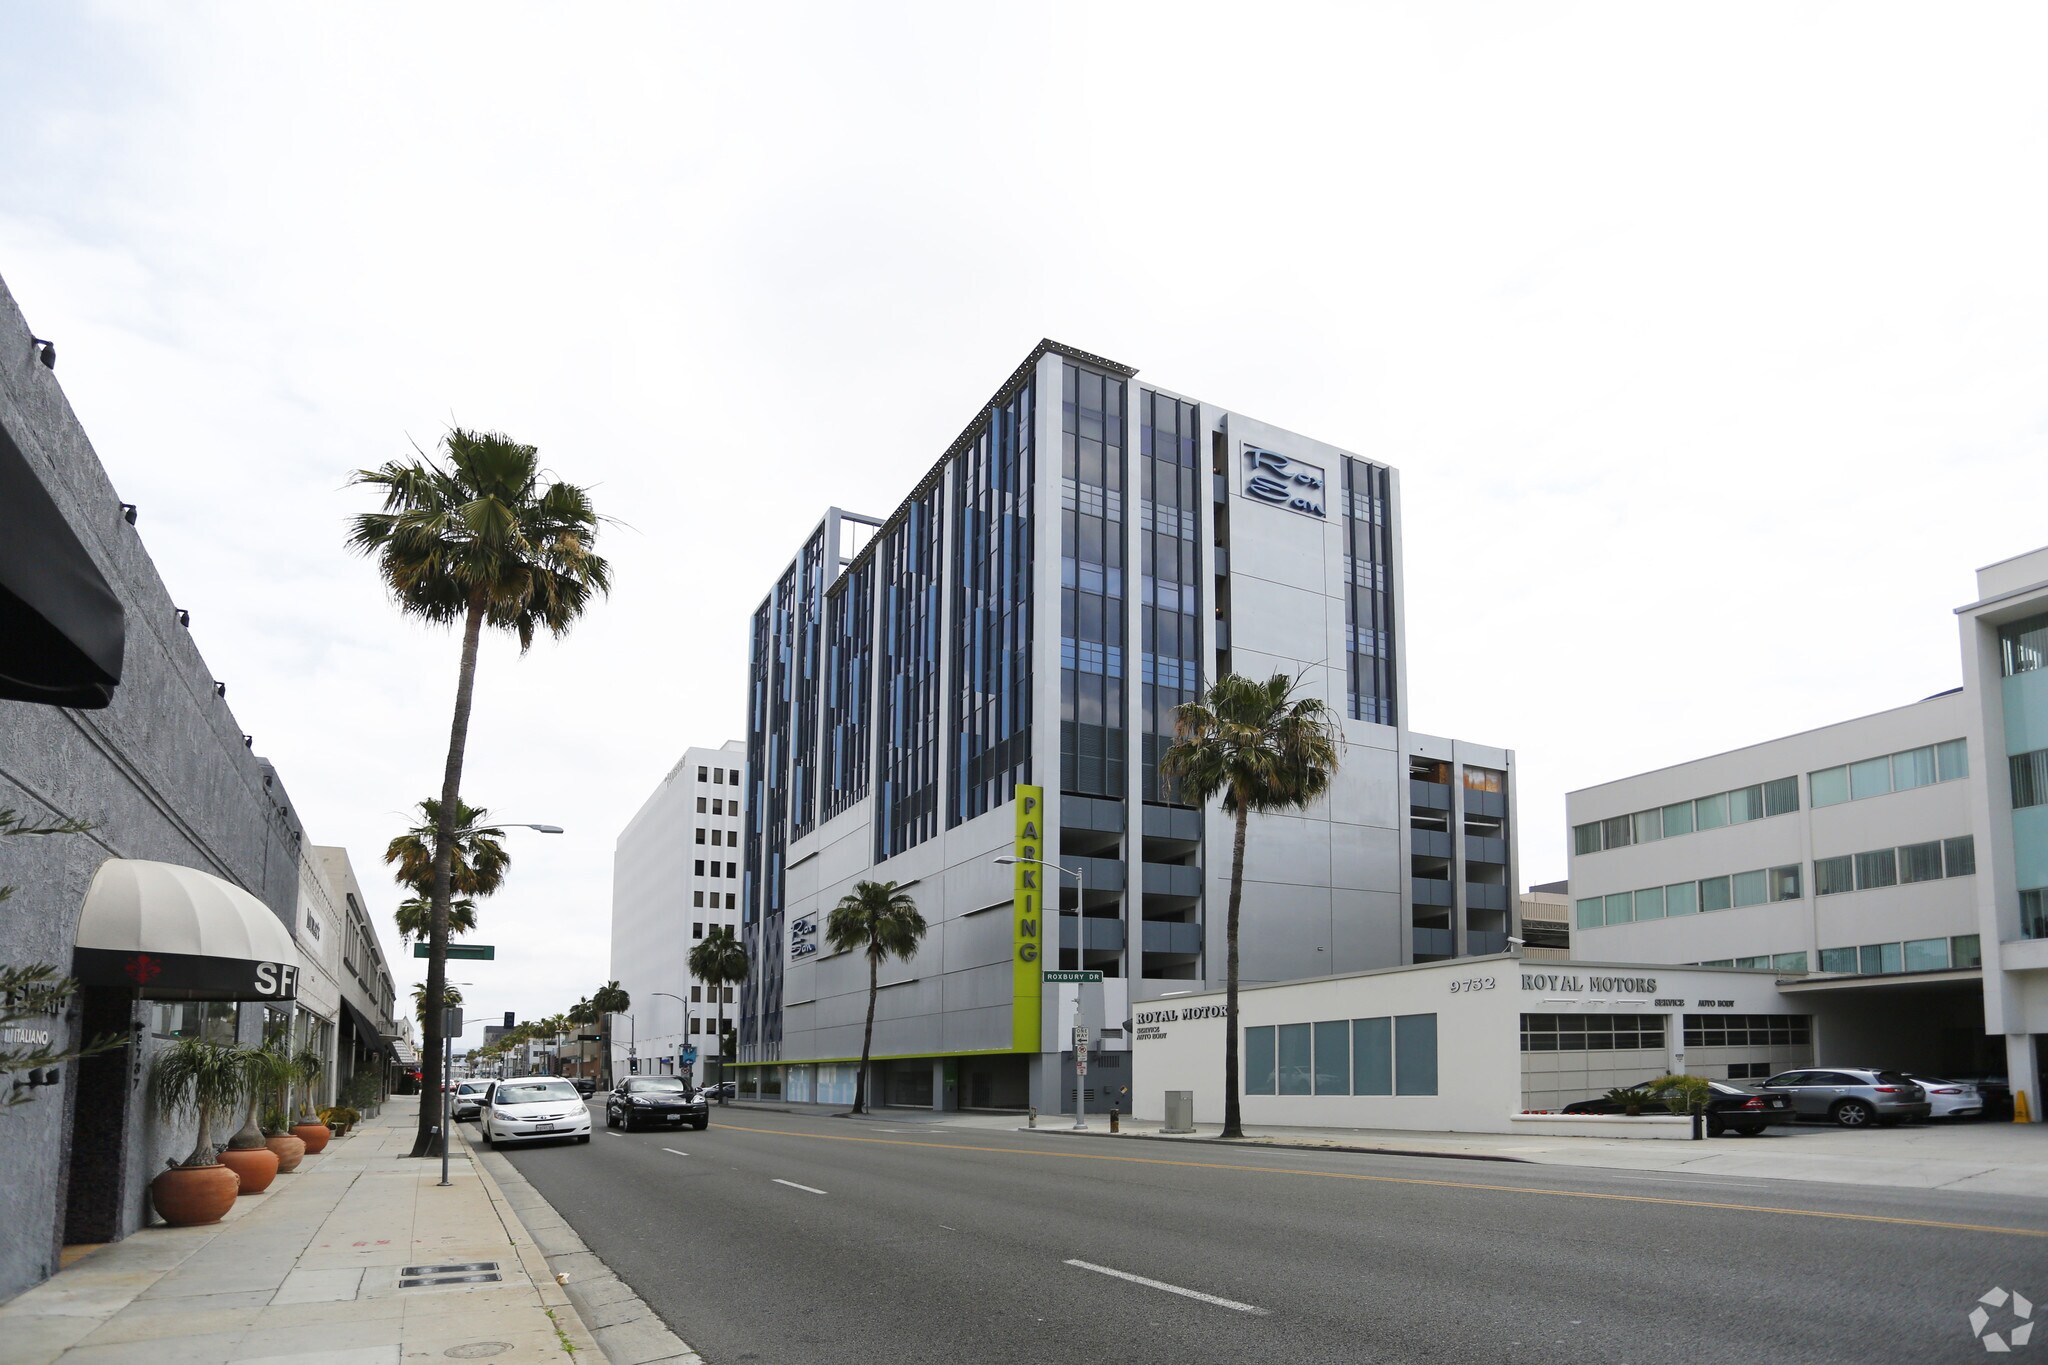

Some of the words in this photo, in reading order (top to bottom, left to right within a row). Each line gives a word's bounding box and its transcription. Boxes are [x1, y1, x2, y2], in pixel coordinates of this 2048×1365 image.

[1019, 796, 1038, 962] PARKING
[254, 962, 299, 998] SF
[1450, 976, 1496, 993] 9732
[1521, 974, 1583, 992] ROYAL
[1589, 976, 1657, 993] MOTORS
[1654, 999, 1685, 1007] SERVICE
[1136, 1010, 1178, 1024] ROYAL
[1182, 1005, 1239, 1020] MOTOR
